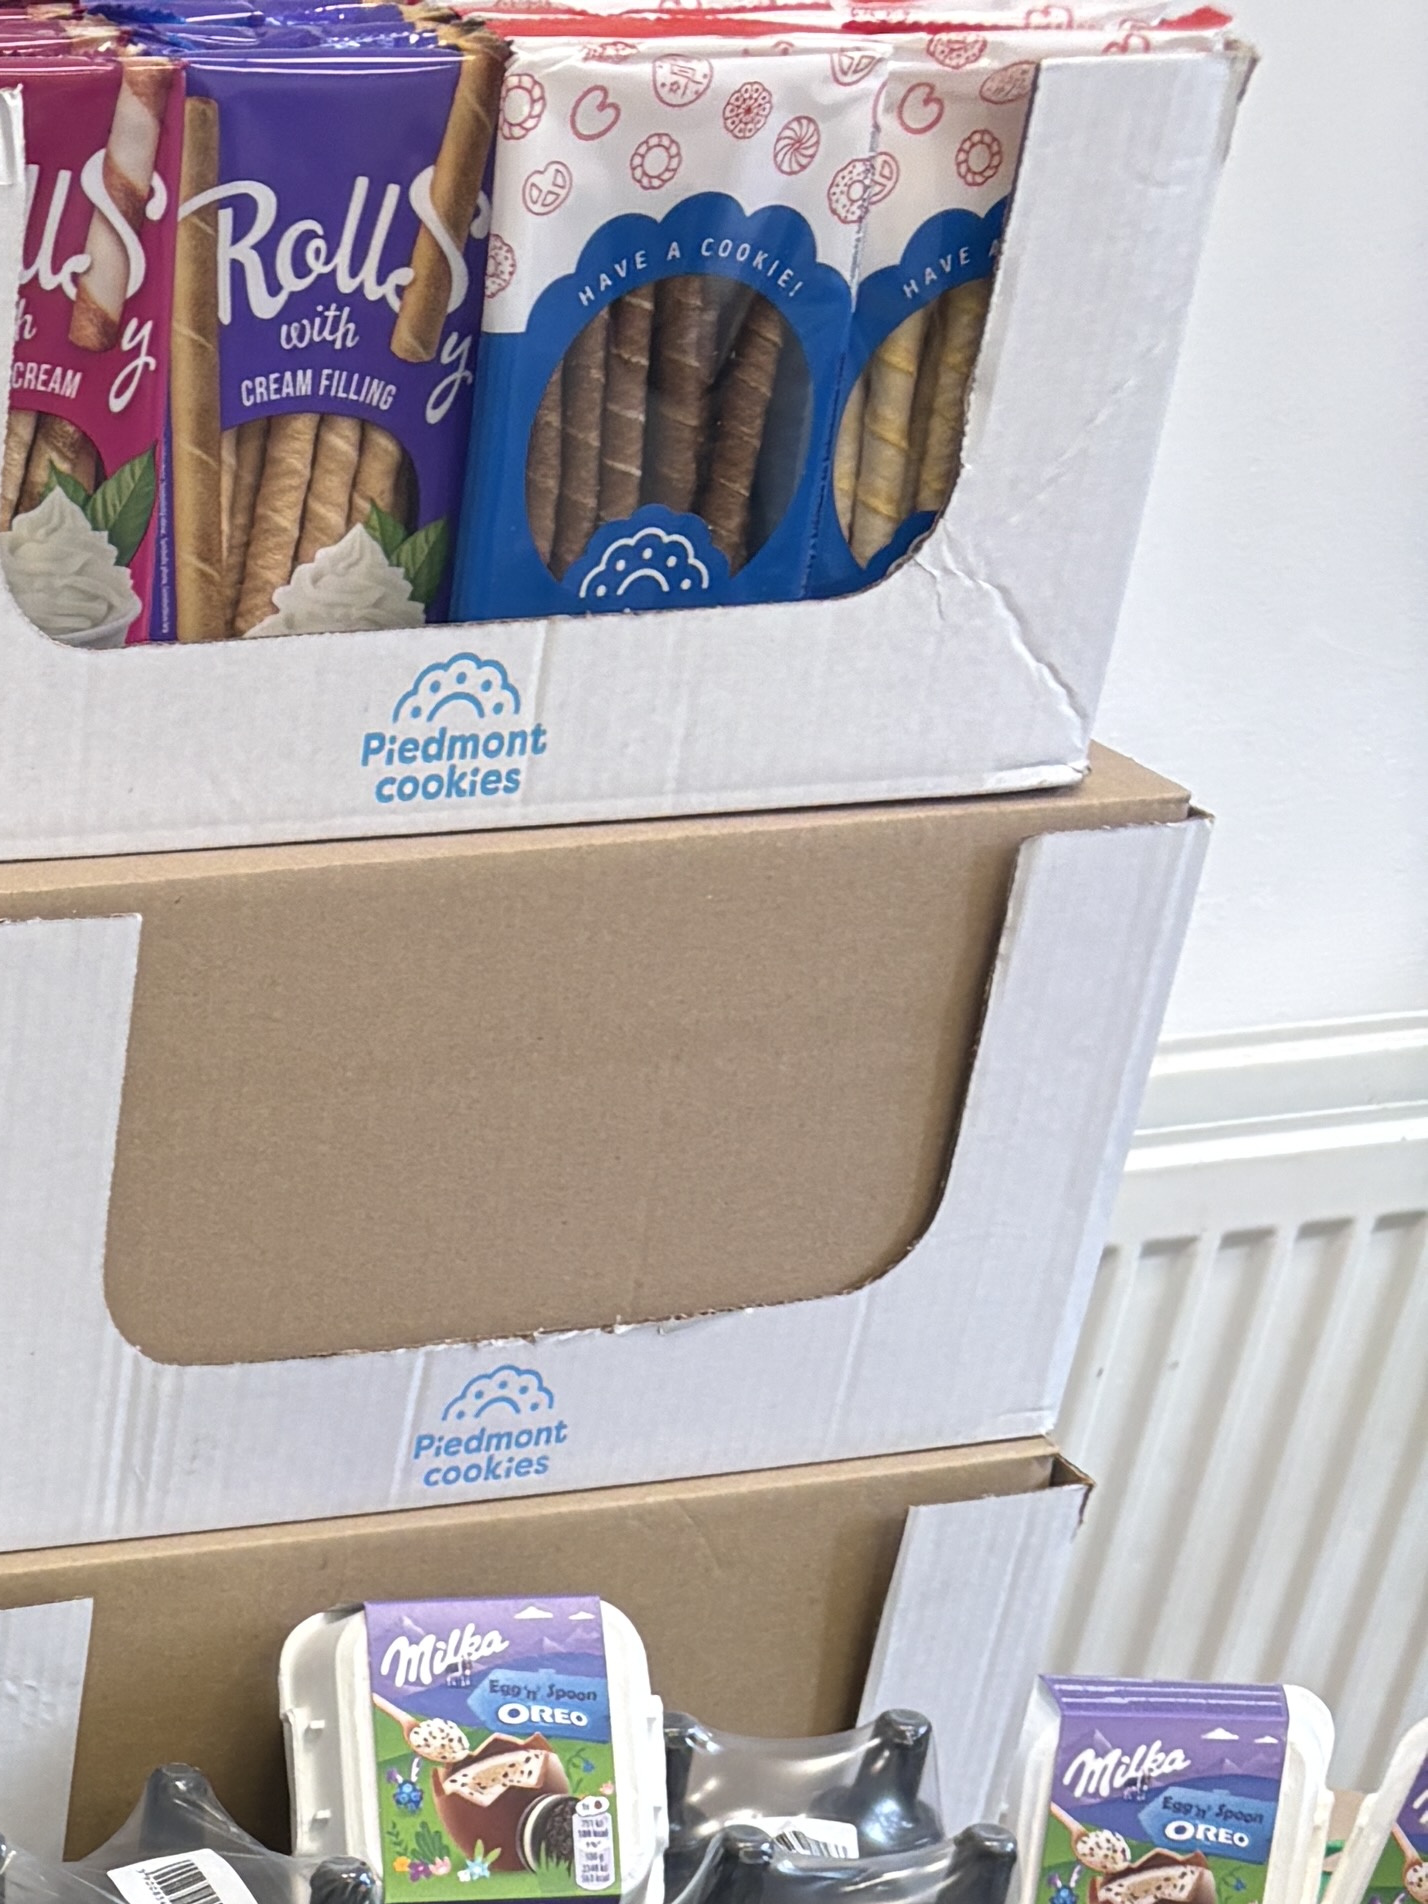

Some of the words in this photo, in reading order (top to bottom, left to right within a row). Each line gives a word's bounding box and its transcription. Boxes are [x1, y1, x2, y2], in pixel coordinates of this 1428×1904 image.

[578, 252, 650, 306] HAVE
[667, 241, 682, 258] A
[701, 237, 806, 297] COOKIE!
[902, 246, 974, 299] HAVE
[281, 303, 359, 349] with
[241, 369, 312, 407] CREAM
[319, 369, 396, 410] FILLING
[361, 724, 547, 766] Piedmont
[375, 768, 521, 803] cookies
[414, 1420, 567, 1460] Piedmont
[423, 1453, 550, 1487] cookies
[381, 1623, 509, 1687] Milka
[546, 1684, 597, 1701] Spoon
[497, 1703, 589, 1727] OREO
[1062, 1740, 1190, 1798] Milka
[1165, 1820, 1249, 1847] OREO
[1216, 1803, 1263, 1824] Spoon
